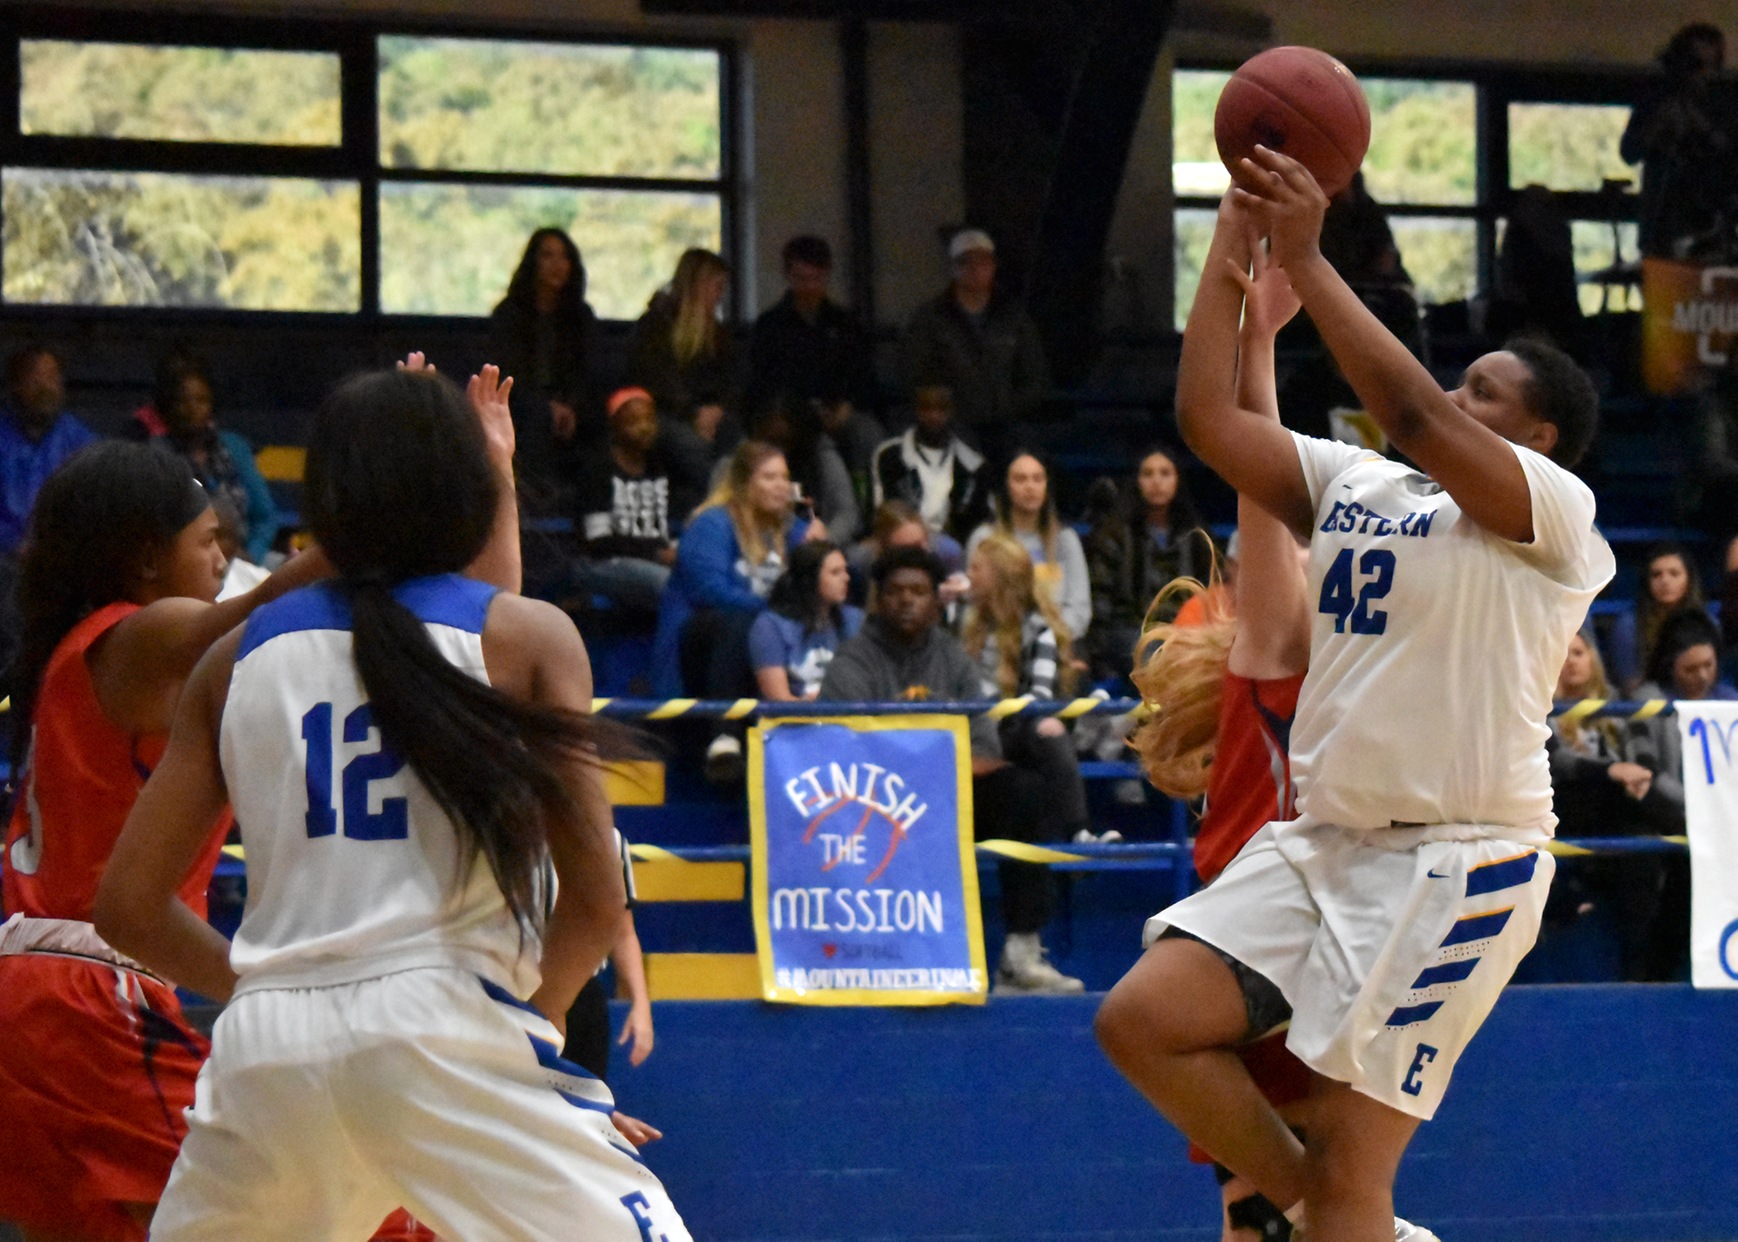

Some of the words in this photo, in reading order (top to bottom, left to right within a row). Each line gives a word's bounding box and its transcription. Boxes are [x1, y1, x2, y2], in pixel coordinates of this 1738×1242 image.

[1319, 548, 1396, 635] 42
[302, 701, 408, 840] 12
[785, 761, 928, 830] FINISH
[818, 833, 866, 864] THE
[773, 888, 944, 933] MISSION
[1401, 1042, 1439, 1096] E
[619, 1190, 671, 1242] E
